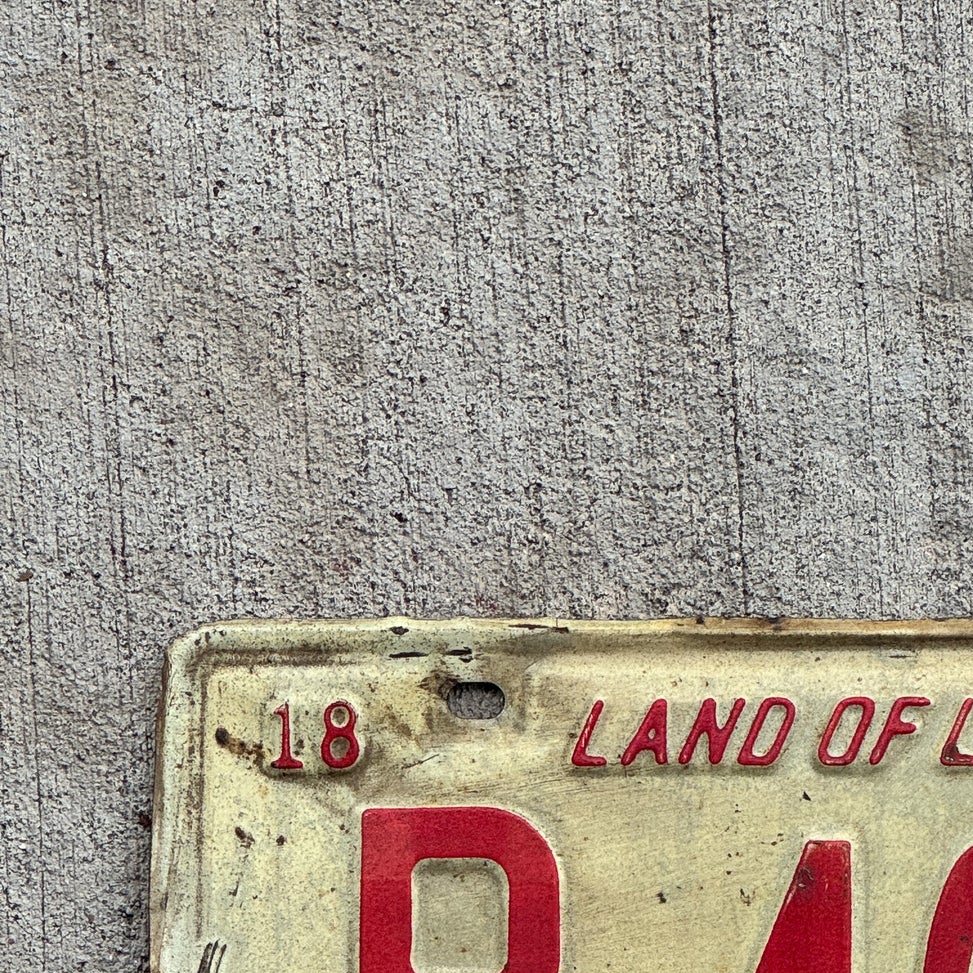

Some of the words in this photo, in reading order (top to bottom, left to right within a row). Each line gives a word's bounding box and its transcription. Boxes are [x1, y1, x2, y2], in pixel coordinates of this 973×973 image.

[270, 700, 361, 770] 18
[572, 698, 796, 768] LAND
[818, 696, 931, 767] OF
